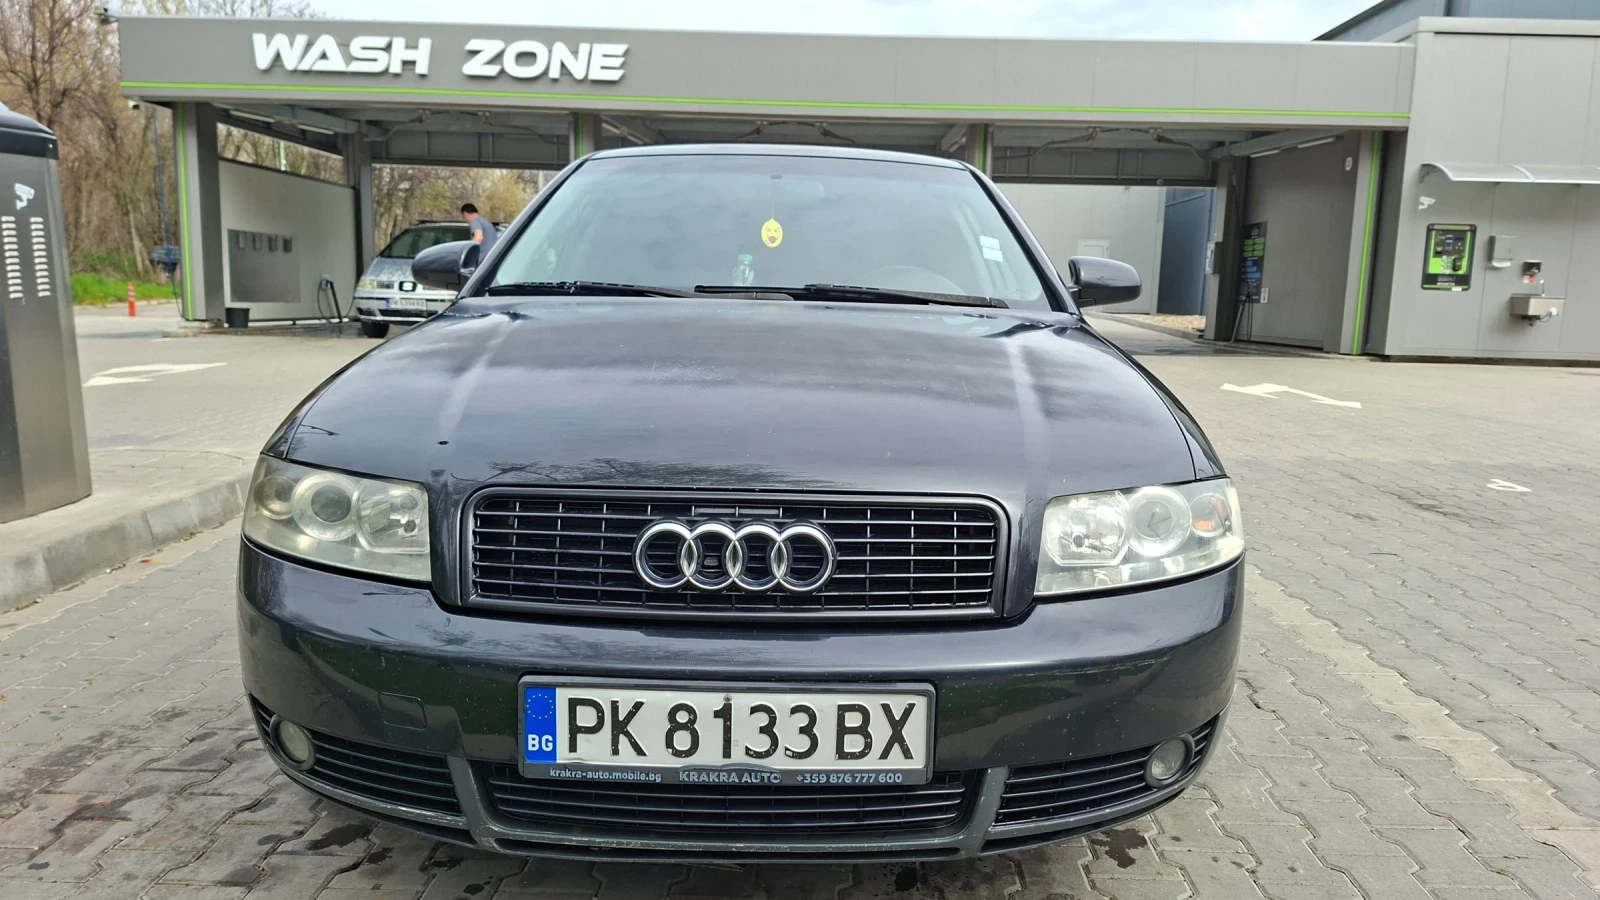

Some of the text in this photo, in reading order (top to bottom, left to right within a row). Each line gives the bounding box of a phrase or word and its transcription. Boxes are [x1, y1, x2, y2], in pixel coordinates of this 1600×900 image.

[252, 32, 630, 82] WASH ZONE
[567, 697, 917, 761] PK 8133 BX
[527, 733, 554, 752] BG
[549, 768, 662, 782] krakra-auto.mobile.bg
[679, 771, 782, 784] KRAKRA AUTO
[796, 772, 903, 784] +359 876 777 600
